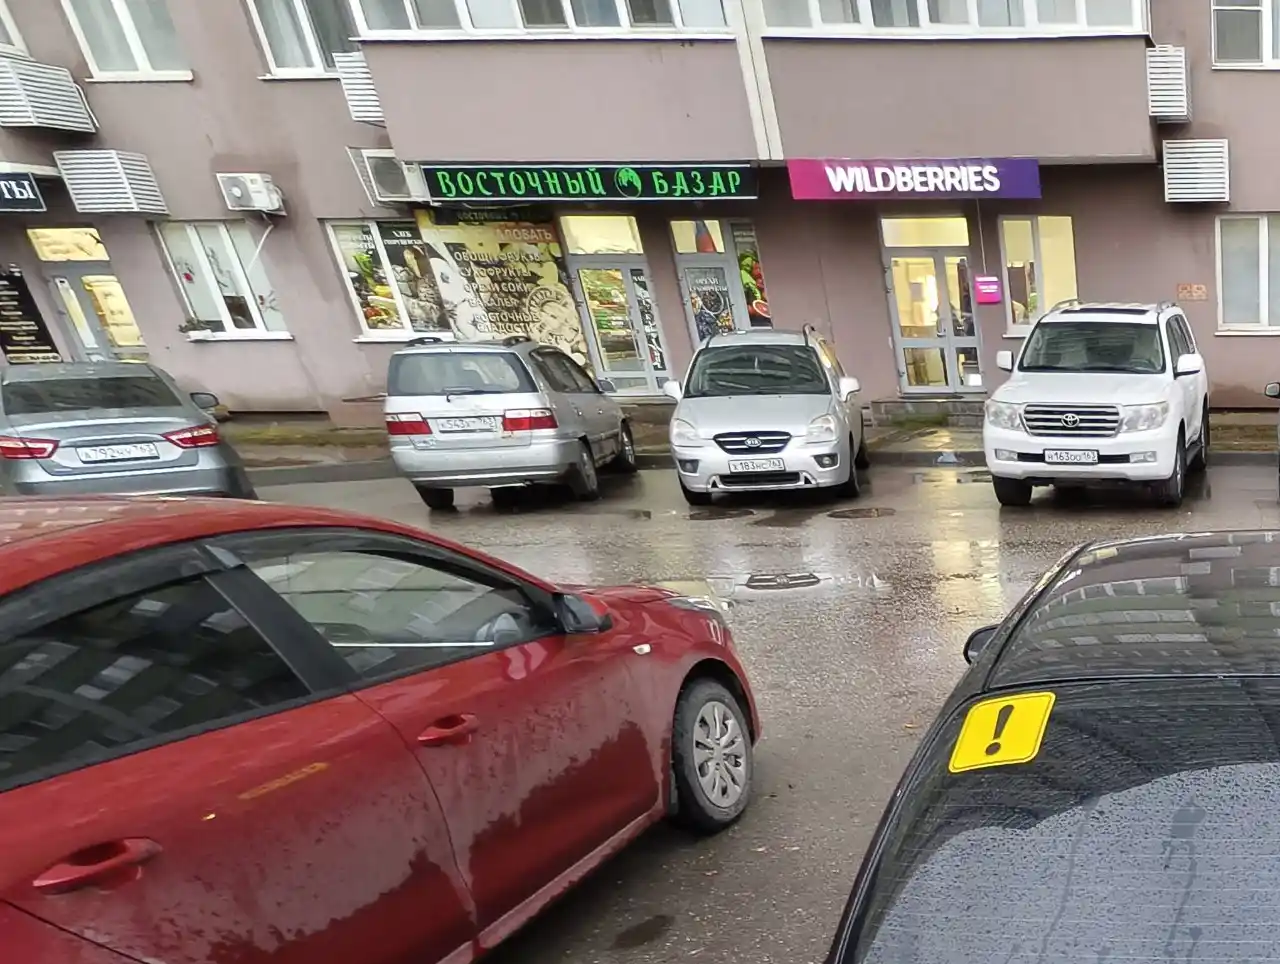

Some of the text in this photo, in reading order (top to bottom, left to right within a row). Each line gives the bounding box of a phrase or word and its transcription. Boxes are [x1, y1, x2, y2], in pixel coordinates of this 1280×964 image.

[436, 168, 741, 197] ВОСТОЧНЫЙ БАЗАР
[825, 165, 1001, 193] WILDBERRIES
